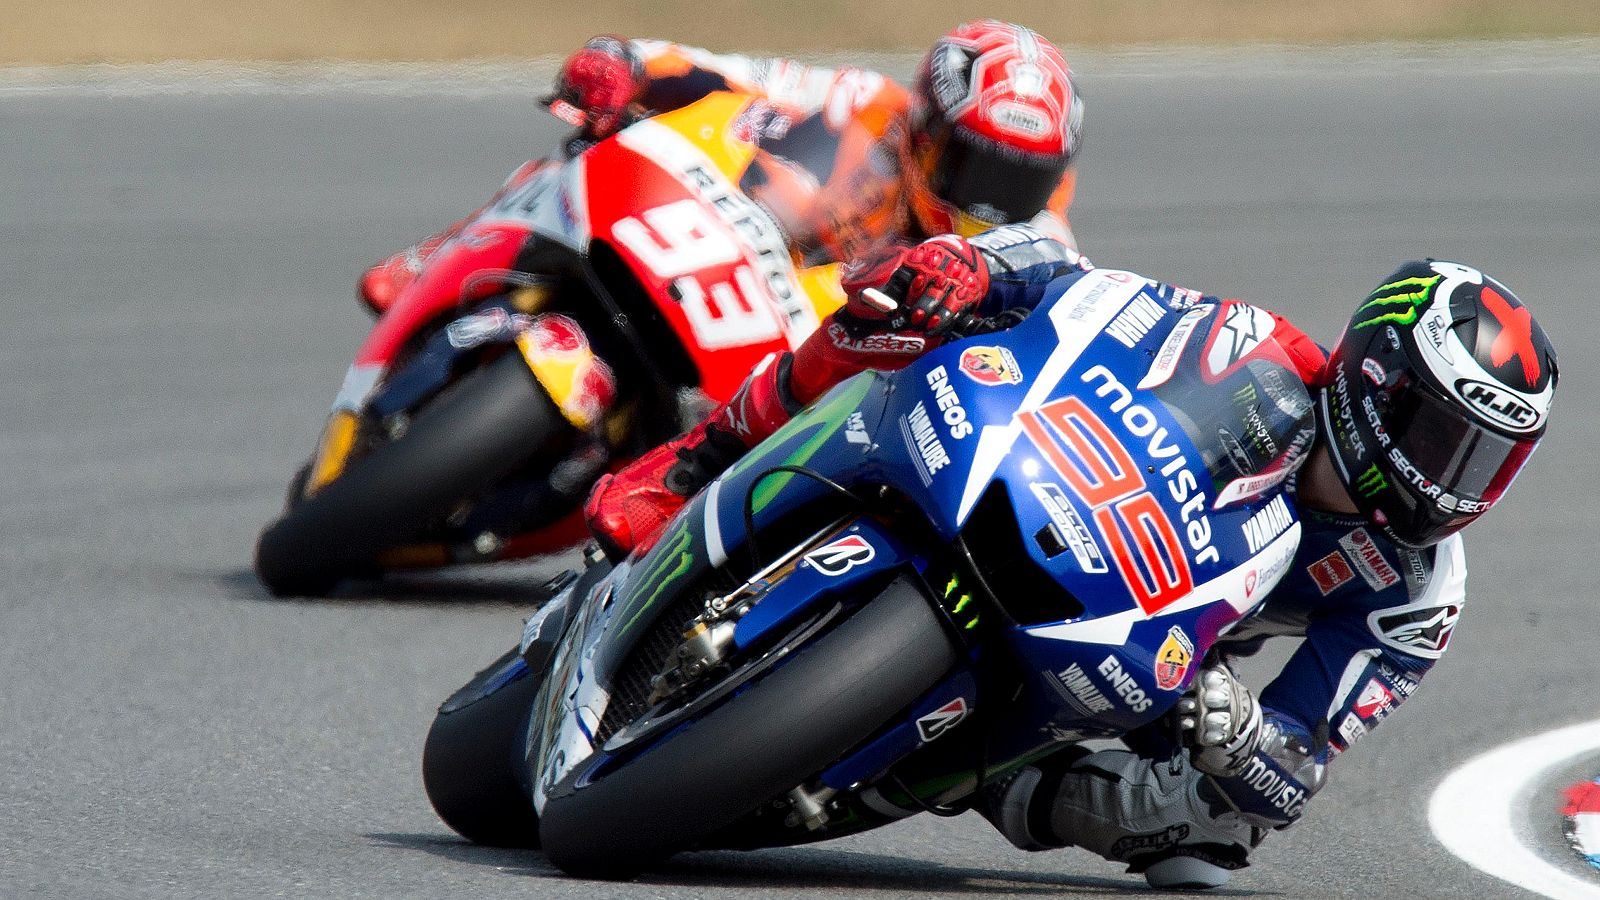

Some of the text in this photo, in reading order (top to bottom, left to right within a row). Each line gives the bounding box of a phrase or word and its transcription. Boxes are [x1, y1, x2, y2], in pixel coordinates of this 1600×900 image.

[611, 199, 781, 350] 93
[1105, 291, 1168, 348] YAMAHA
[1427, 321, 1442, 348] RPHA
[925, 365, 973, 439] ENEOS
[1247, 403, 1279, 458] MONSTER
[1336, 361, 1366, 460] MONSTER
[1467, 386, 1533, 424] HJC
[908, 400, 950, 475] YAMALUBE
[1081, 365, 1219, 564] movistar
[1362, 395, 1391, 448] SECTOR
[1388, 448, 1442, 500] SECTOR
[1016, 395, 1194, 616] 99
[1241, 494, 1293, 554] YAMAHA
[1321, 561, 1340, 584] ENEOS
[1360, 542, 1398, 585] YAMAHA
[1058, 662, 1114, 713] YAMALUBE
[1098, 655, 1152, 713] ENEOS
